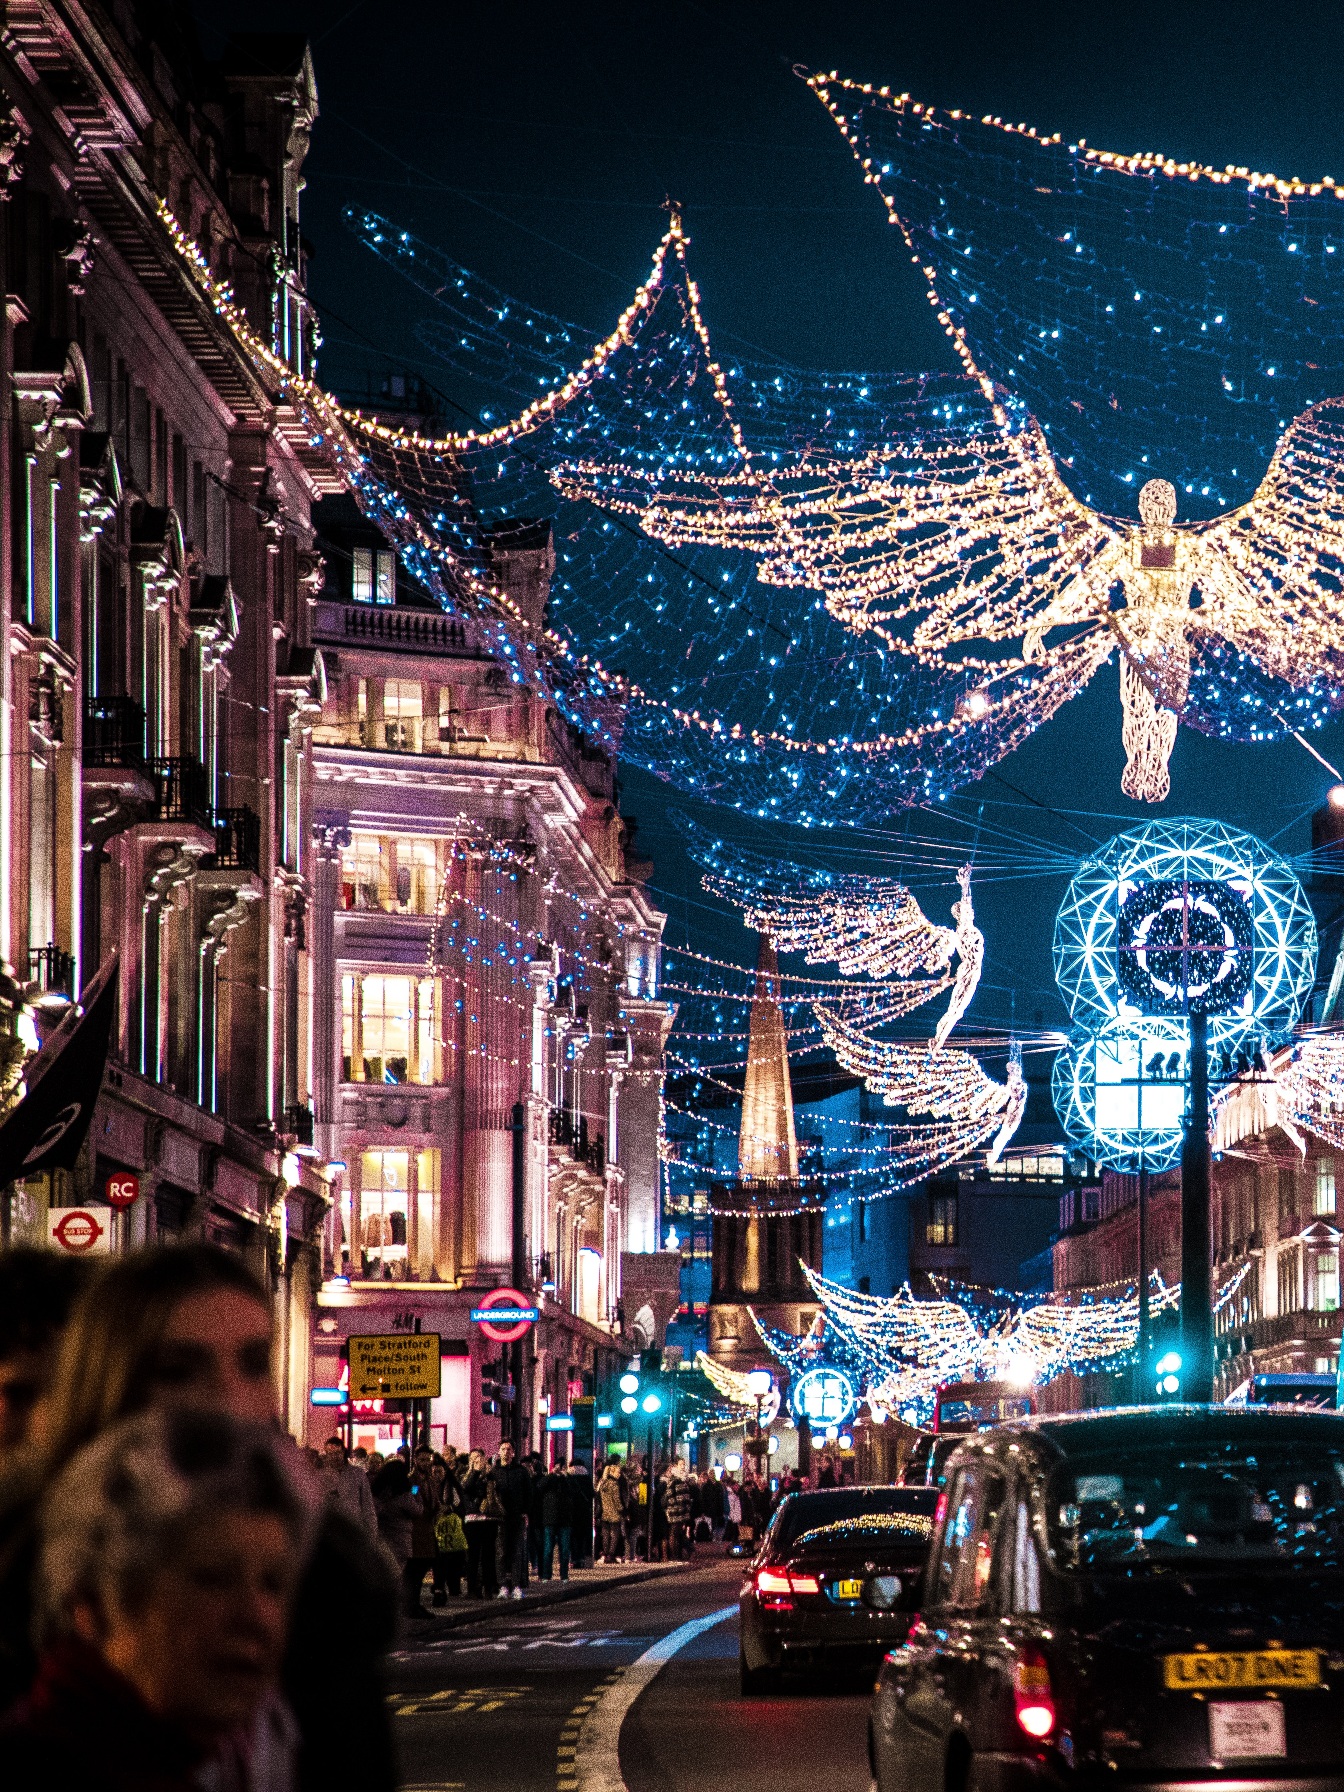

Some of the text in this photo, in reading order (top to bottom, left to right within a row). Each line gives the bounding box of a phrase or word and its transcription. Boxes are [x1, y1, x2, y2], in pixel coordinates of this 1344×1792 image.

[109, 1182, 134, 1198] RC
[473, 1311, 535, 1320] UNDERGROUND
[357, 1339, 431, 1351] For Stratford
[409, 1364, 421, 1374] St
[394, 1382, 428, 1392] follow
